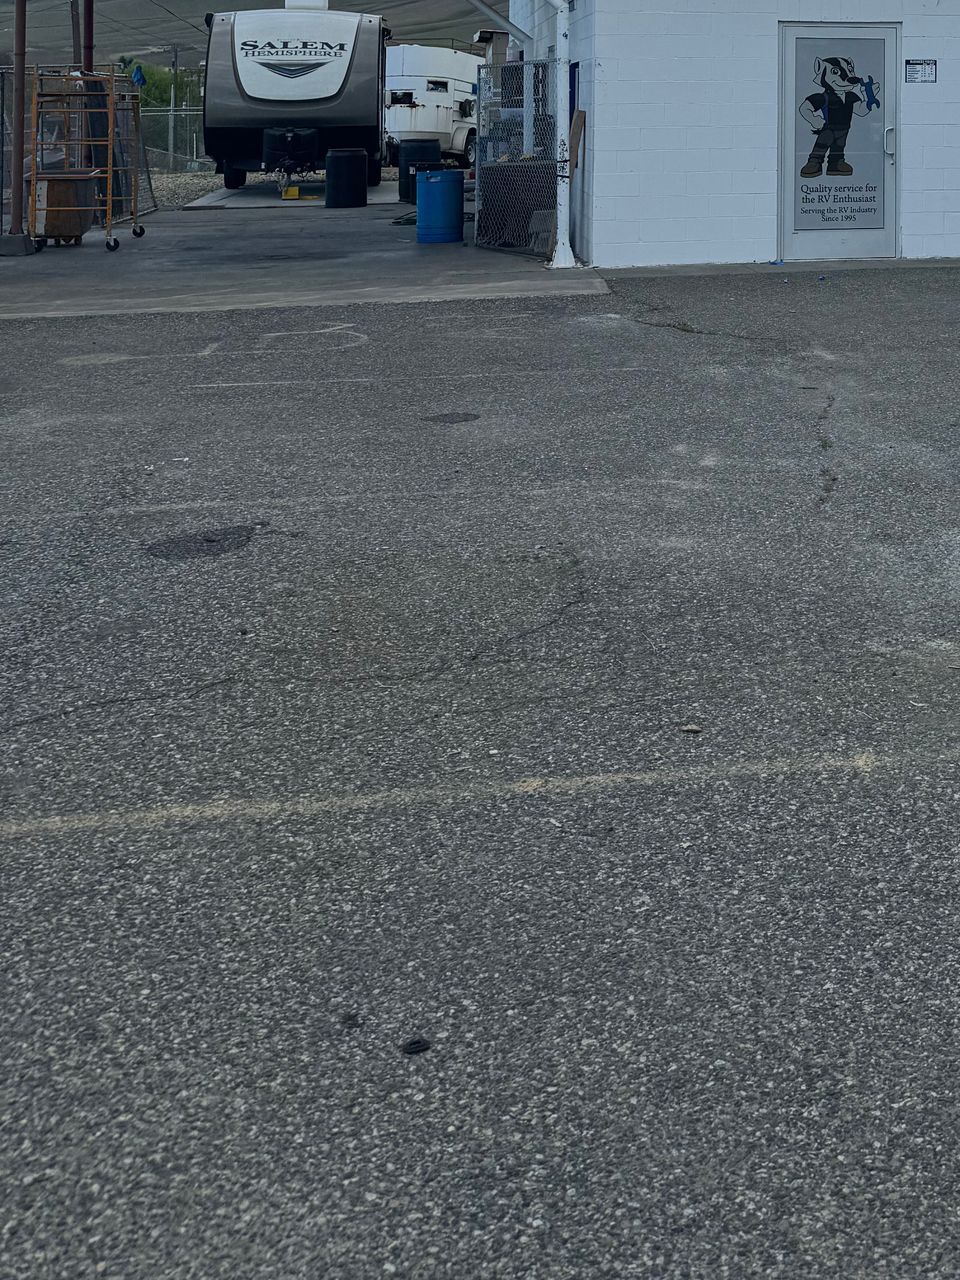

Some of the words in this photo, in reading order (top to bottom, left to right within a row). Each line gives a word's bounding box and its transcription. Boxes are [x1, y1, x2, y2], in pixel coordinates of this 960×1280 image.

[241, 40, 347, 52] SALEM
[243, 50, 343, 58] HEMISPHERE
[801, 184, 832, 195] Quality
[834, 184, 863, 192] service
[865, 183, 877, 192] for
[818, 195, 831, 203] RV
[833, 194, 876, 203] Enthusiast
[801, 207, 825, 215] Serving
[850, 206, 877, 215] Industry
